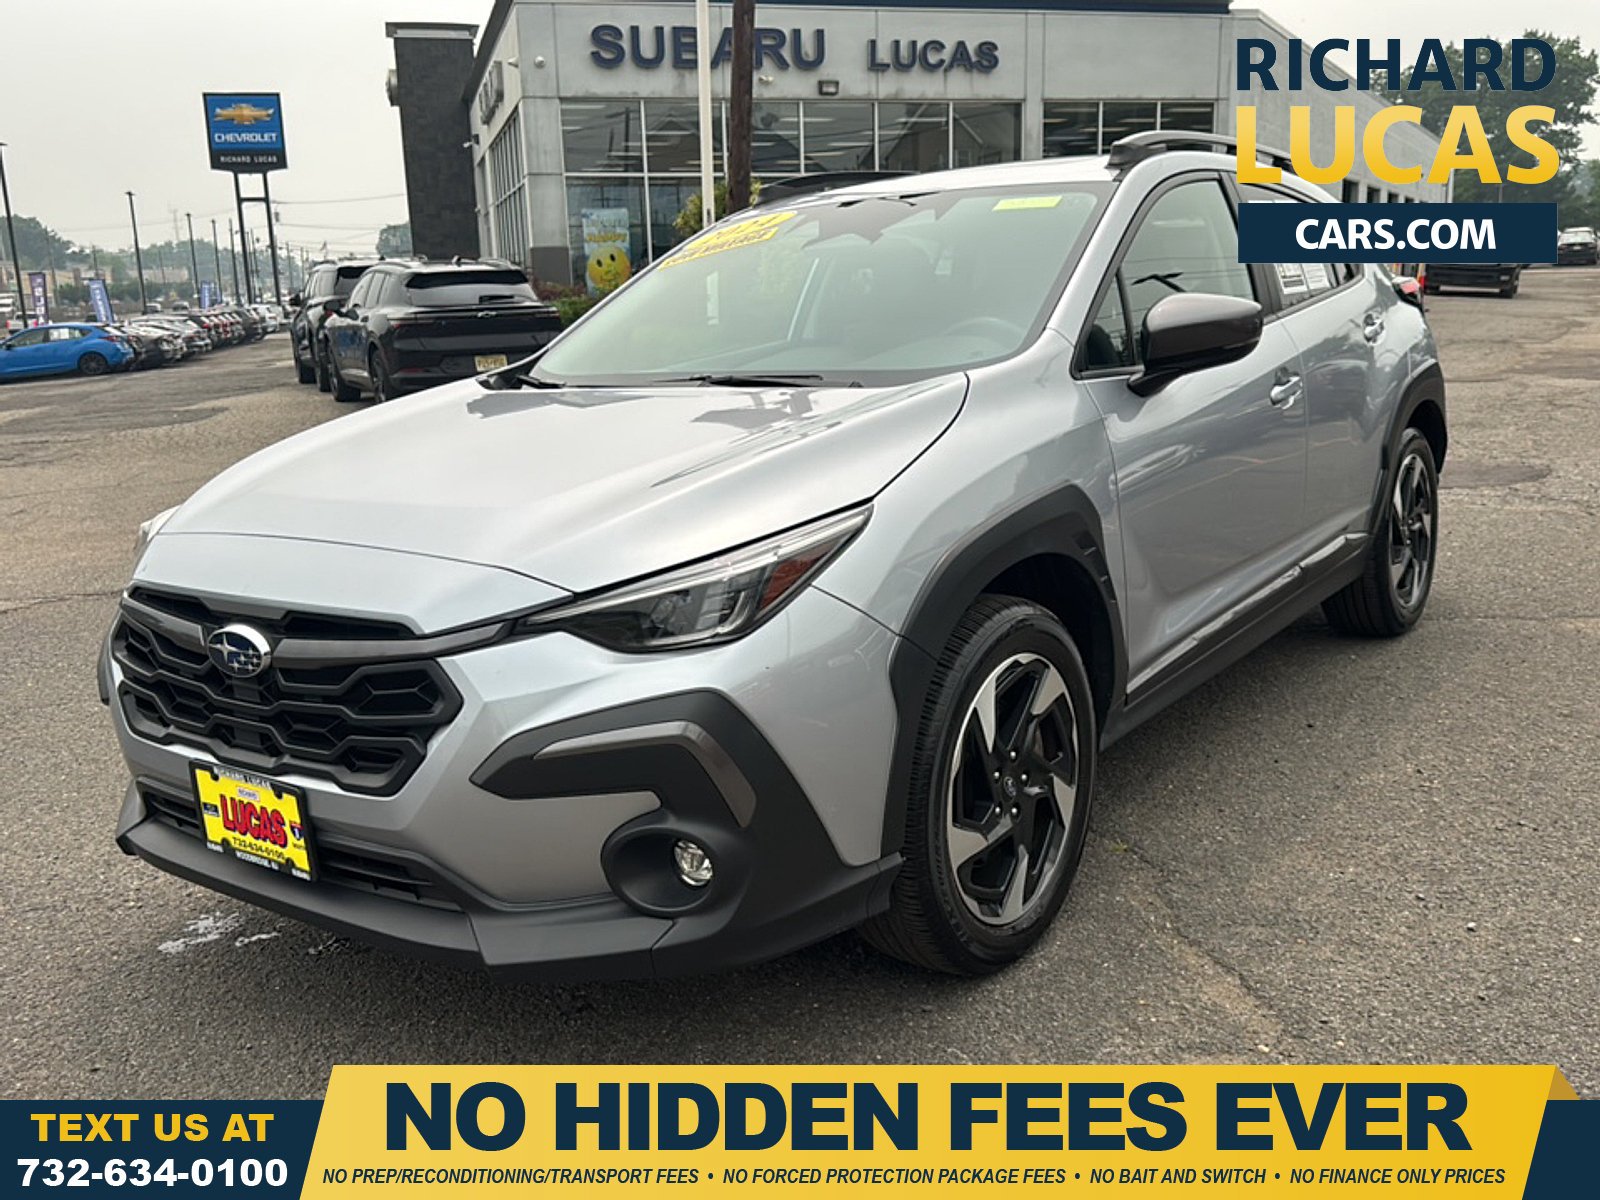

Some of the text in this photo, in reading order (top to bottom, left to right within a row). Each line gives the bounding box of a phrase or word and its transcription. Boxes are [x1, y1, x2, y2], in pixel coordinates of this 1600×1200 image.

[590, 24, 1000, 74] SUBARU LUCAS
[213, 132, 278, 143] CHEVROLET
[220, 155, 278, 163] RICHARD LUCAS
[219, 794, 287, 848] LUCAS
